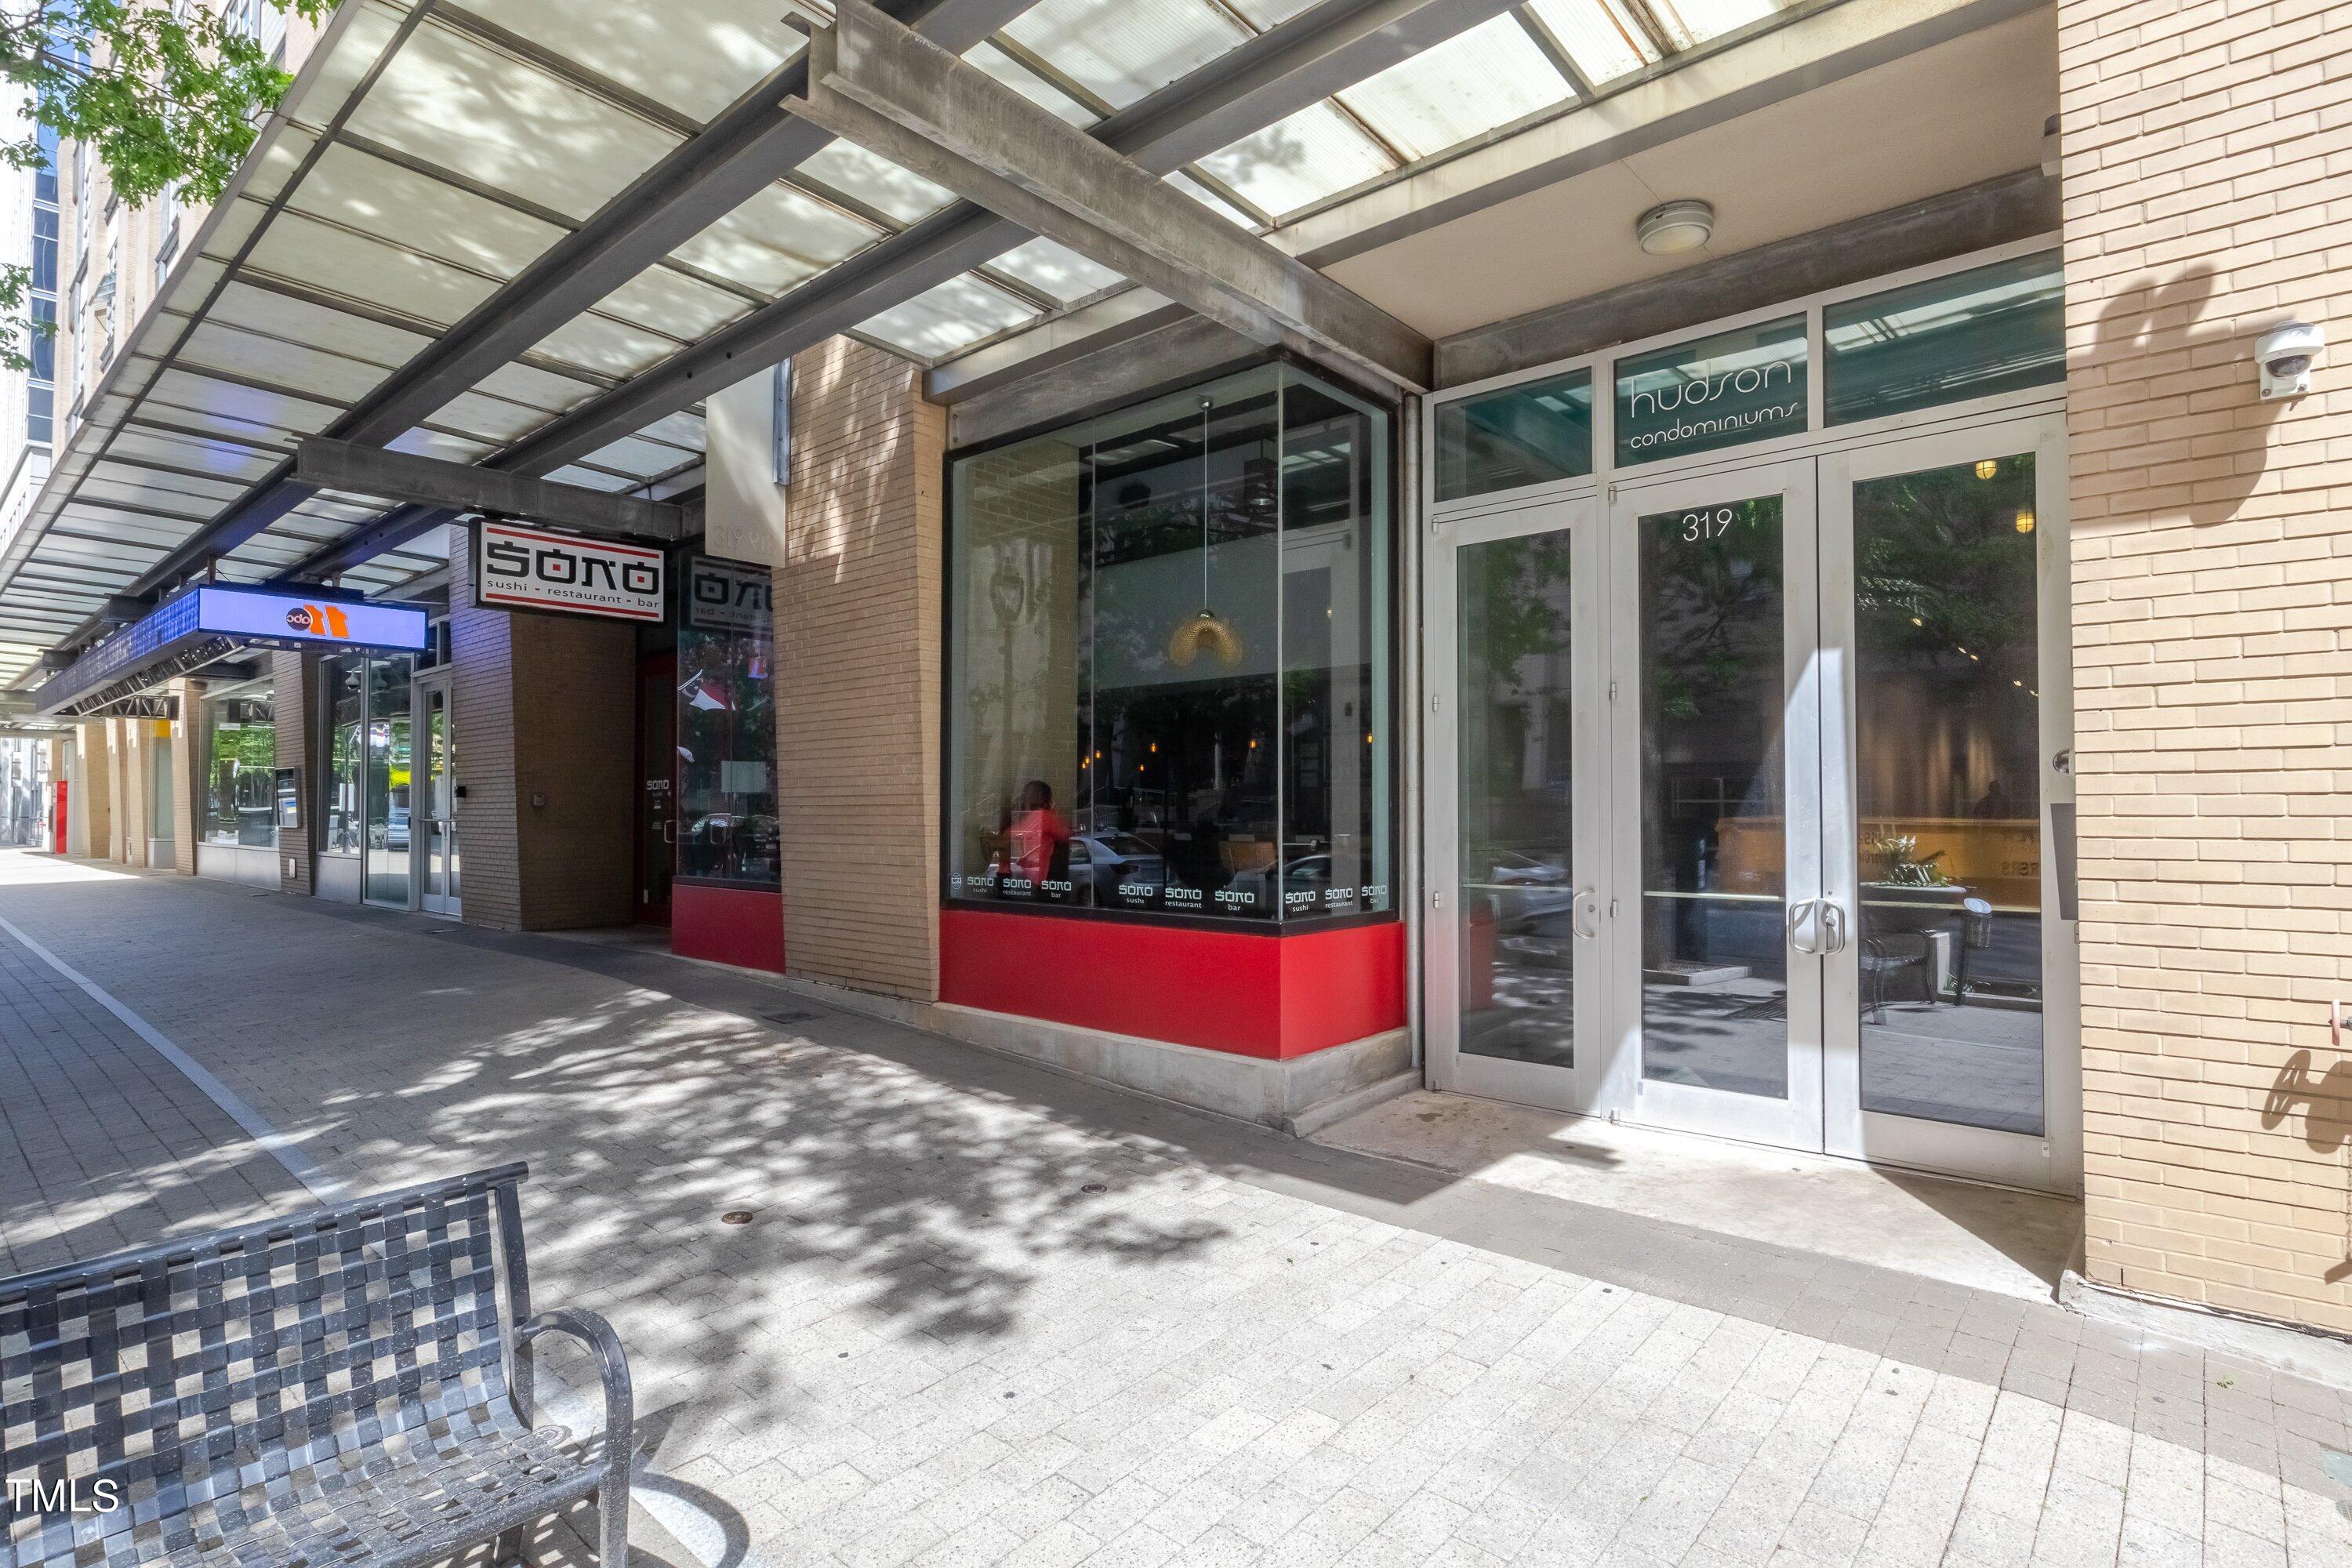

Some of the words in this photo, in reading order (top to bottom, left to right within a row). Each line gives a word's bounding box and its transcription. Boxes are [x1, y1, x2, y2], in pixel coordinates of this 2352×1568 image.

[1632, 358, 1791, 418] hudson
[1631, 402, 1798, 448] condominiums
[1682, 508, 1733, 542] 319
[487, 540, 659, 595] SONO
[487, 579, 528, 592] sushi
[548, 588, 622, 604] restaurant
[637, 597, 659, 608] bar
[967, 876, 994, 887] SONO
[1003, 878, 1032, 888] SONO
[1041, 880, 1072, 891] SONO
[1119, 884, 1153, 897] SONO
[1165, 887, 1202, 900] SONO
[1215, 890, 1254, 903] SONO
[1285, 890, 1316, 904] SONO
[1325, 887, 1353, 900] SONO
[1361, 884, 1387, 897] SONO
[1292, 904, 1308, 913] sushi
[1325, 900, 1353, 909] restaurant
